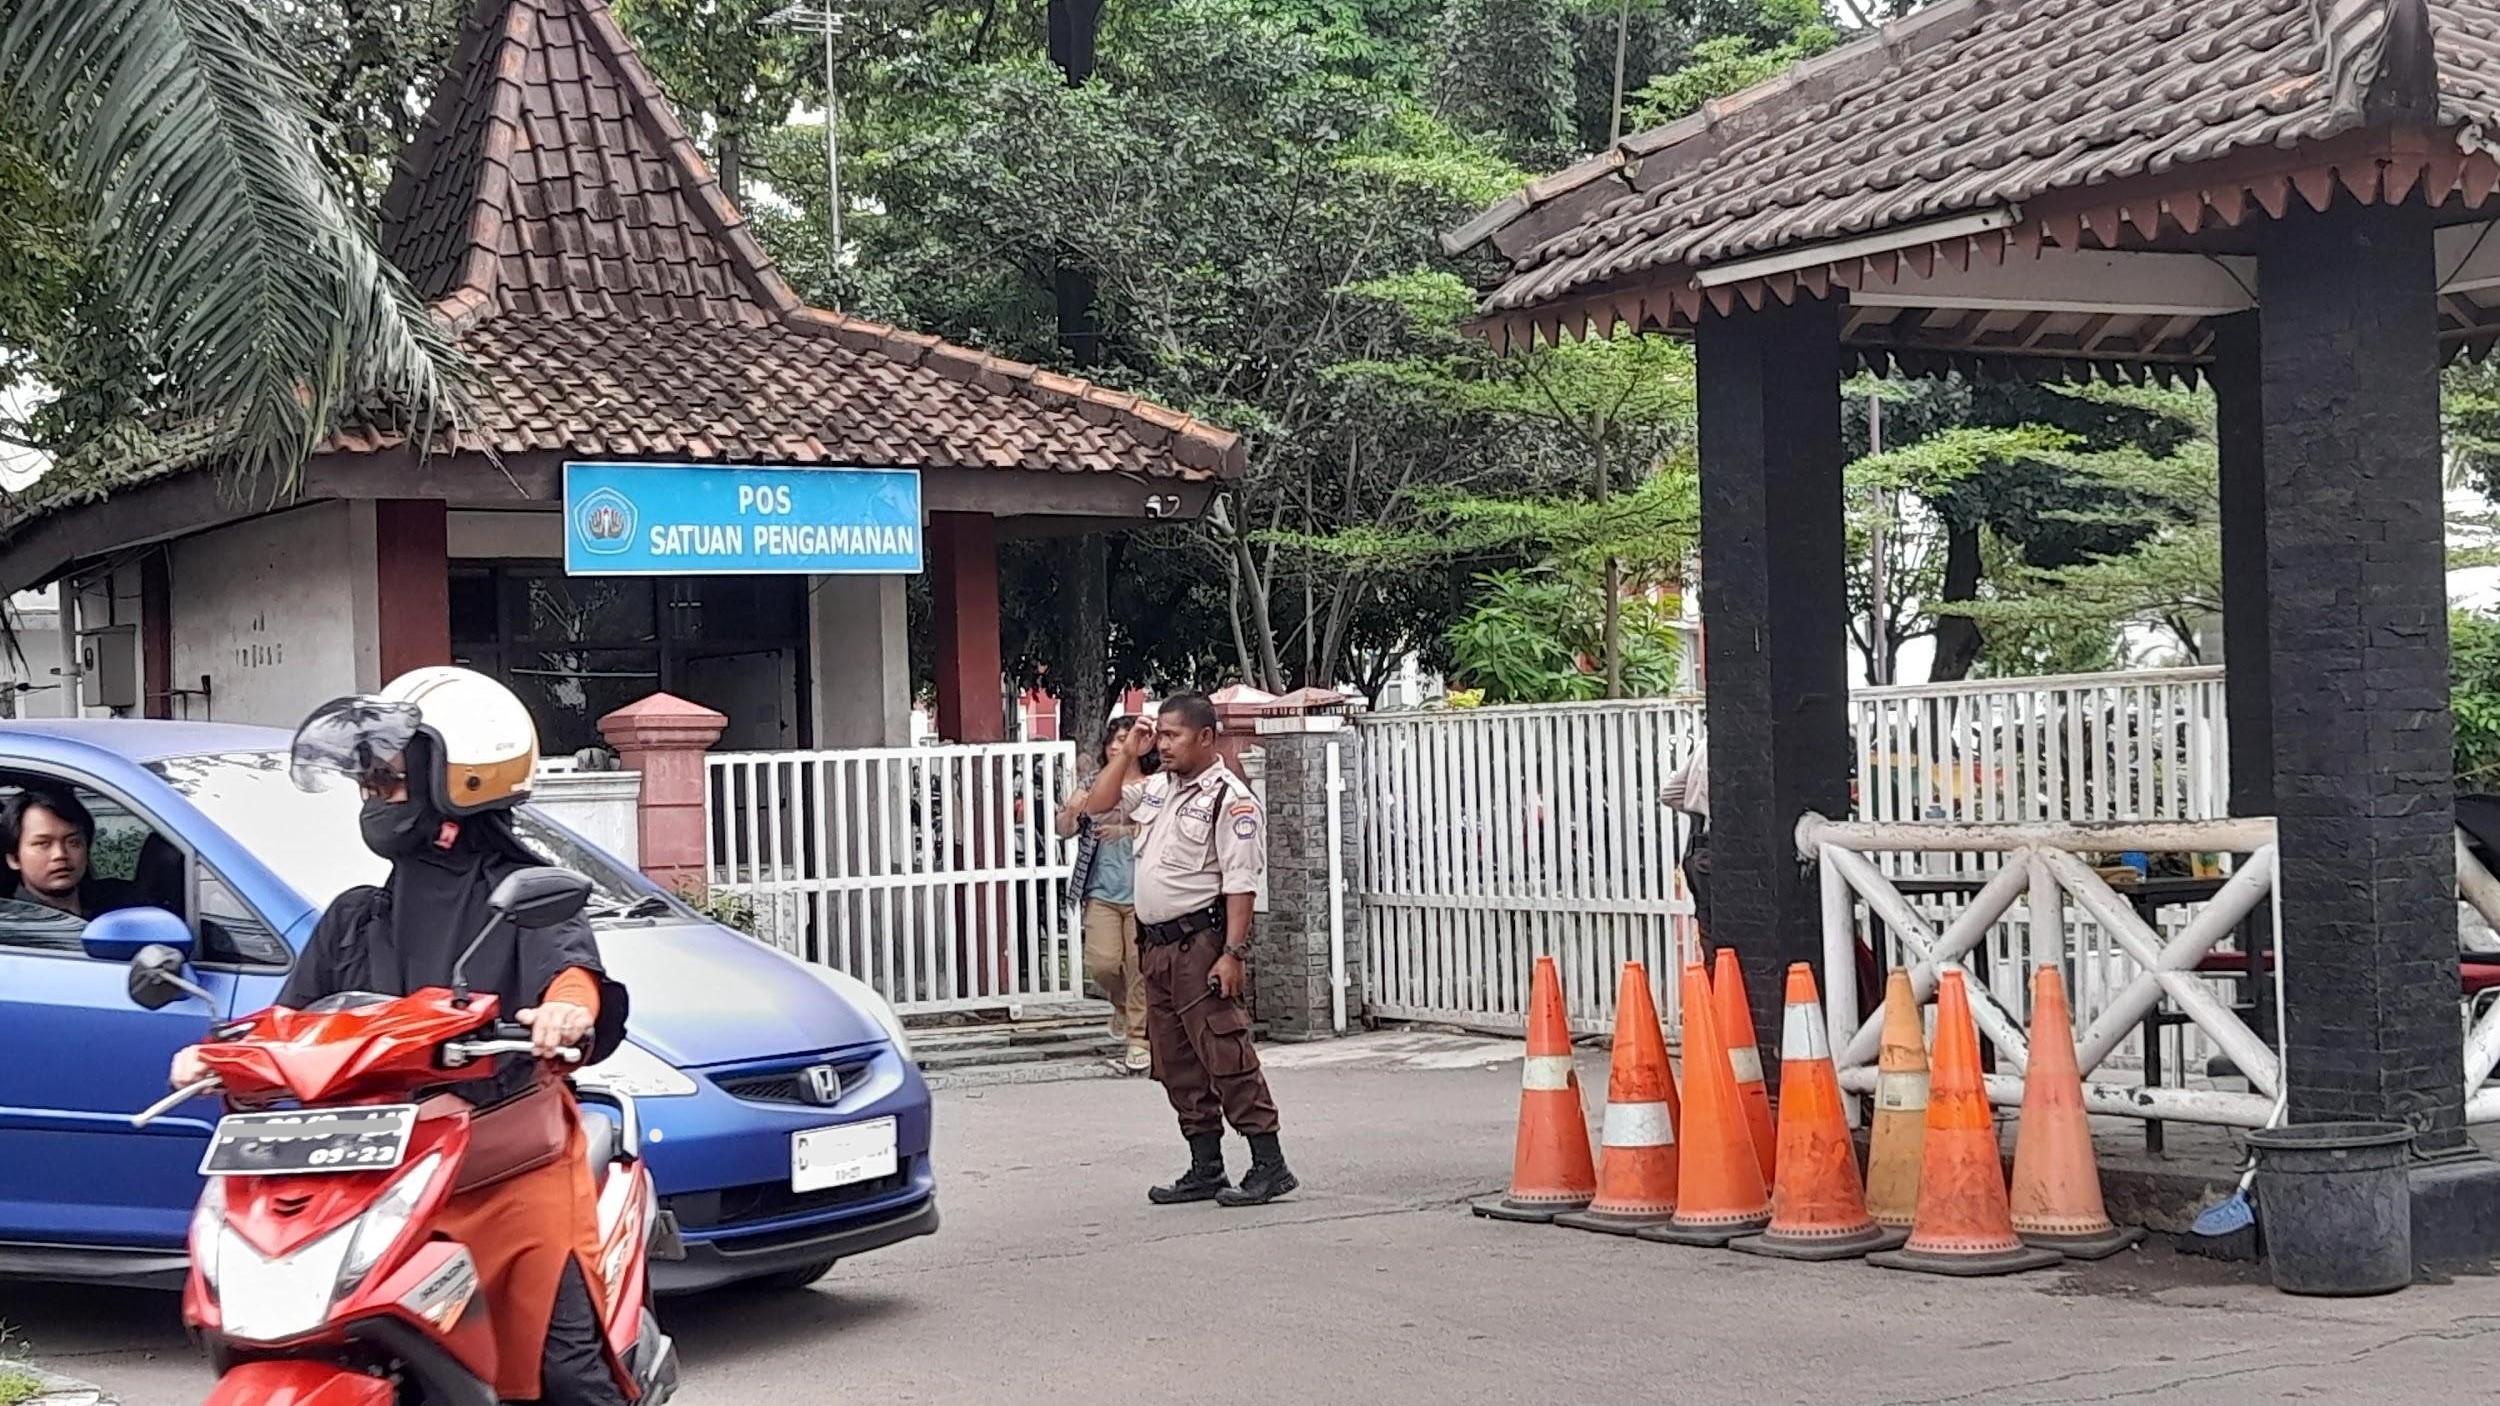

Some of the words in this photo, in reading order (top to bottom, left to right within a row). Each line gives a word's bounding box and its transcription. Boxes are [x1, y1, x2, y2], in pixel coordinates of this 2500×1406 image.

[738, 485, 792, 515] POS
[649, 525, 743, 556] SATUAN
[754, 525, 914, 556] PENGAMANAN
[308, 1146, 396, 1164] 09-23
